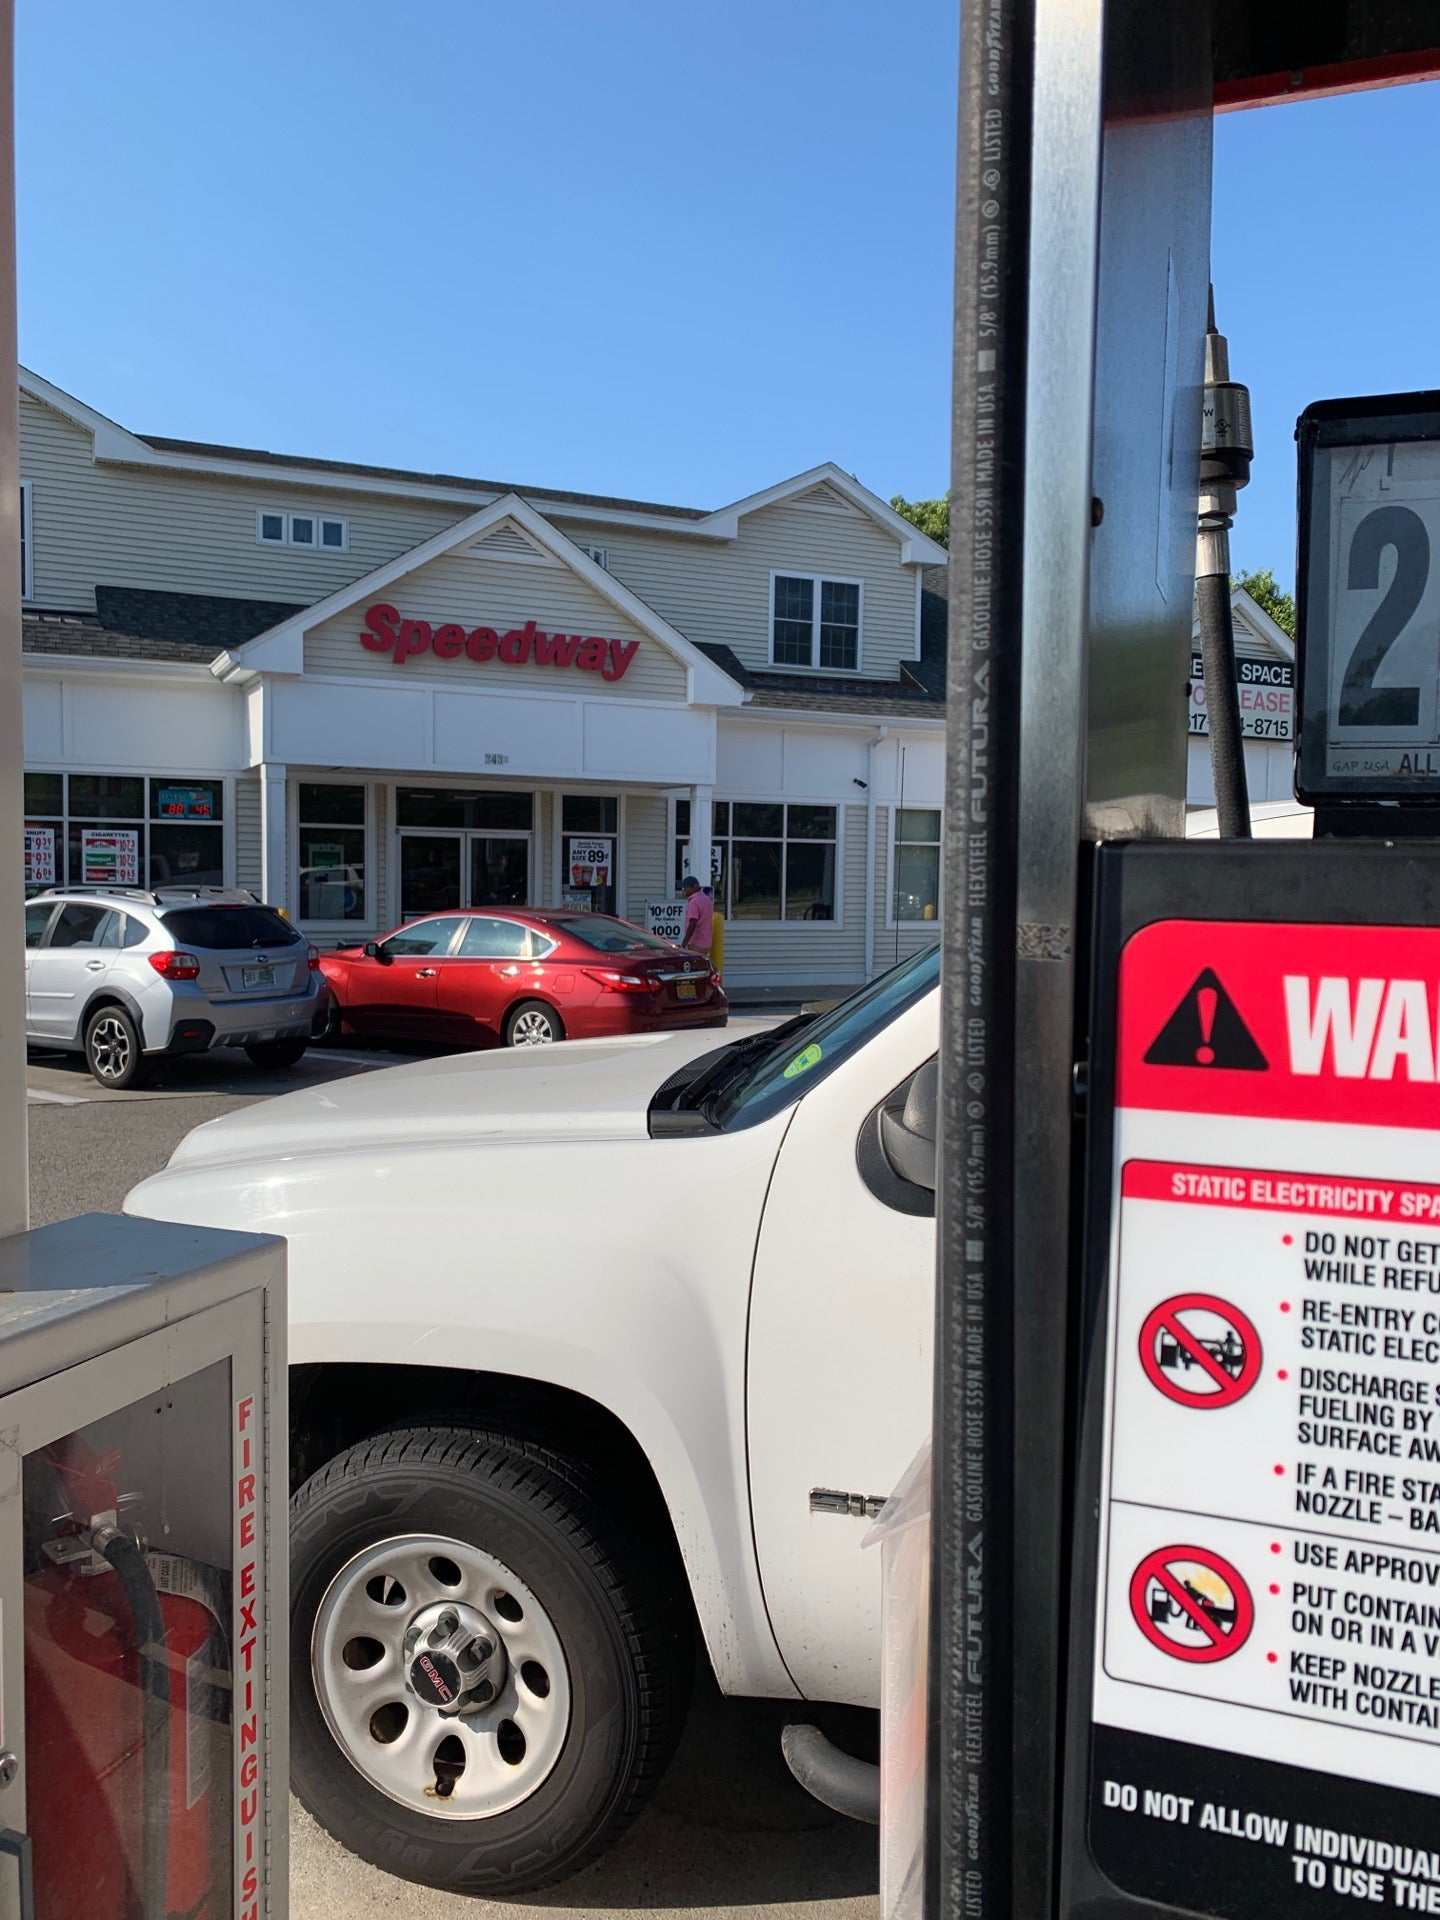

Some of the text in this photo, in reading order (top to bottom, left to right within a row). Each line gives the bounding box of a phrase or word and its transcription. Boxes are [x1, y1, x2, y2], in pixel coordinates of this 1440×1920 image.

[983, 109, 1002, 161] LISTED
[979, 225, 1001, 299] (15.9mm)
[976, 384, 996, 412] USA
[976, 420, 995, 434] IN
[975, 441, 995, 482] MADE
[974, 531, 993, 570] HOSE
[972, 576, 992, 651] GASOLINE
[1338, 505, 1430, 726] 2
[360, 603, 640, 682] Speedway
[1241, 663, 1291, 685] SPACE
[1240, 689, 1291, 713] EASE
[971, 660, 990, 822] FUTURA
[1363, 761, 1389, 772] USA
[1398, 753, 1438, 774] ALL
[968, 830, 988, 906] FLEXSTEEL
[651, 925, 681, 937] 1000
[667, 905, 684, 917] OFF
[967, 917, 985, 1006] GOODYEAR
[967, 1018, 986, 1065] LISTED
[1283, 974, 1440, 1083] WA
[1172, 1172, 1440, 1219] STATIC ELECTRICITY SPA
[1305, 1231, 1440, 1266] DO NOT GET
[966, 1272, 984, 1300] USA
[1304, 1258, 1440, 1294] WHILE REFU
[966, 1304, 984, 1320] IN
[1302, 1299, 1440, 1335] RE-ENTRY C
[966, 1326, 984, 1365] MADE
[1301, 1326, 1440, 1364] STATIC ELEC
[1300, 1366, 1429, 1406] DISCHARGE
[966, 1411, 984, 1447] HOSE
[1300, 1394, 1433, 1433] FUELING BY
[1298, 1421, 1440, 1463] SURFACE AW
[238, 1396, 255, 1549] FIRE
[966, 1453, 984, 1521] GASOLINE
[1297, 1462, 1440, 1505] IF A FIRE STA
[1296, 1490, 1382, 1525] NOZZLE
[1410, 1507, 1440, 1534] BA
[1294, 1541, 1440, 1587] USE APPROV
[967, 1532, 983, 1684] FUTURA
[1293, 1582, 1440, 1629] PUT CONTAIN
[1292, 1610, 1323, 1636] ON
[1331, 1617, 1363, 1644] OR
[1371, 1624, 1394, 1650] IN
[1401, 1631, 1416, 1654] A
[420, 1656, 453, 1702] GMC
[1291, 1651, 1440, 1701] KEEP NOZZLE
[1289, 1678, 1439, 1729] WITH CONTAI
[965, 1692, 983, 1764] FLEXSTEEL
[965, 1773, 982, 1860] GOODYEAR
[1103, 1780, 1440, 1880] DO NOT ALLOW INDIVIDUAL
[965, 1870, 982, 1917] LISTED
[1292, 1855, 1440, 1915] TO USE THE
